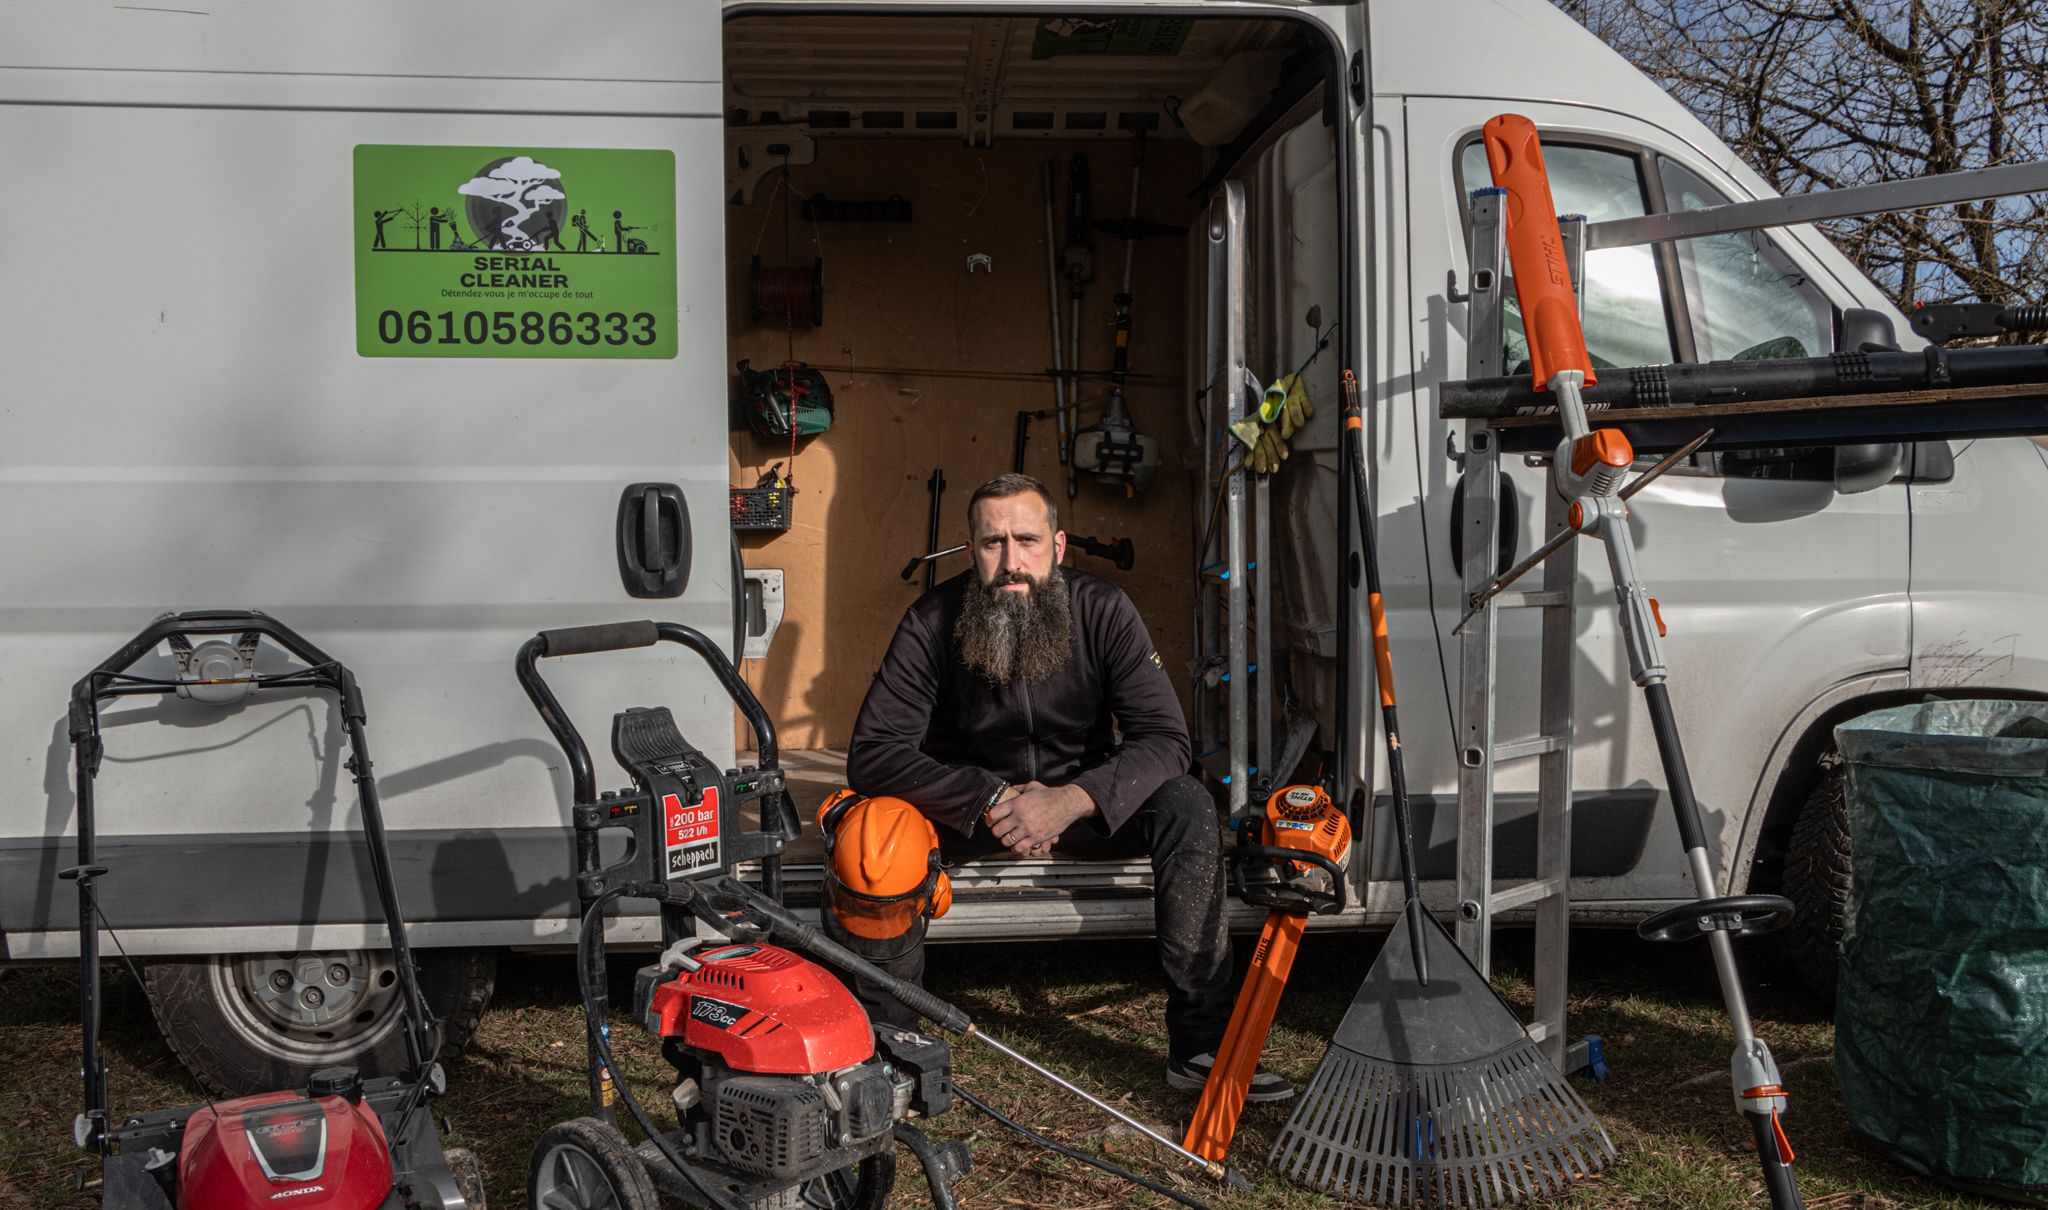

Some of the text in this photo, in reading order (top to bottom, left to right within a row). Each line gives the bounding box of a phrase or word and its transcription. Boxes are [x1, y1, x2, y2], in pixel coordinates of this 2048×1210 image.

[474, 256, 561, 272] SERIAL
[1542, 237, 1564, 287] STIHL
[460, 273, 569, 289] CLEANER
[441, 289, 594, 300] Détendez-vous je m'occupe de tout
[378, 309, 657, 346] 0610586333
[674, 812, 695, 827] 200
[697, 809, 714, 822] bar
[678, 828, 695, 840] 522
[672, 841, 715, 869] scheppach
[1254, 937, 1270, 964] STIHL
[693, 1000, 737, 1025] 173cc
[270, 1186, 325, 1199] HONDA
